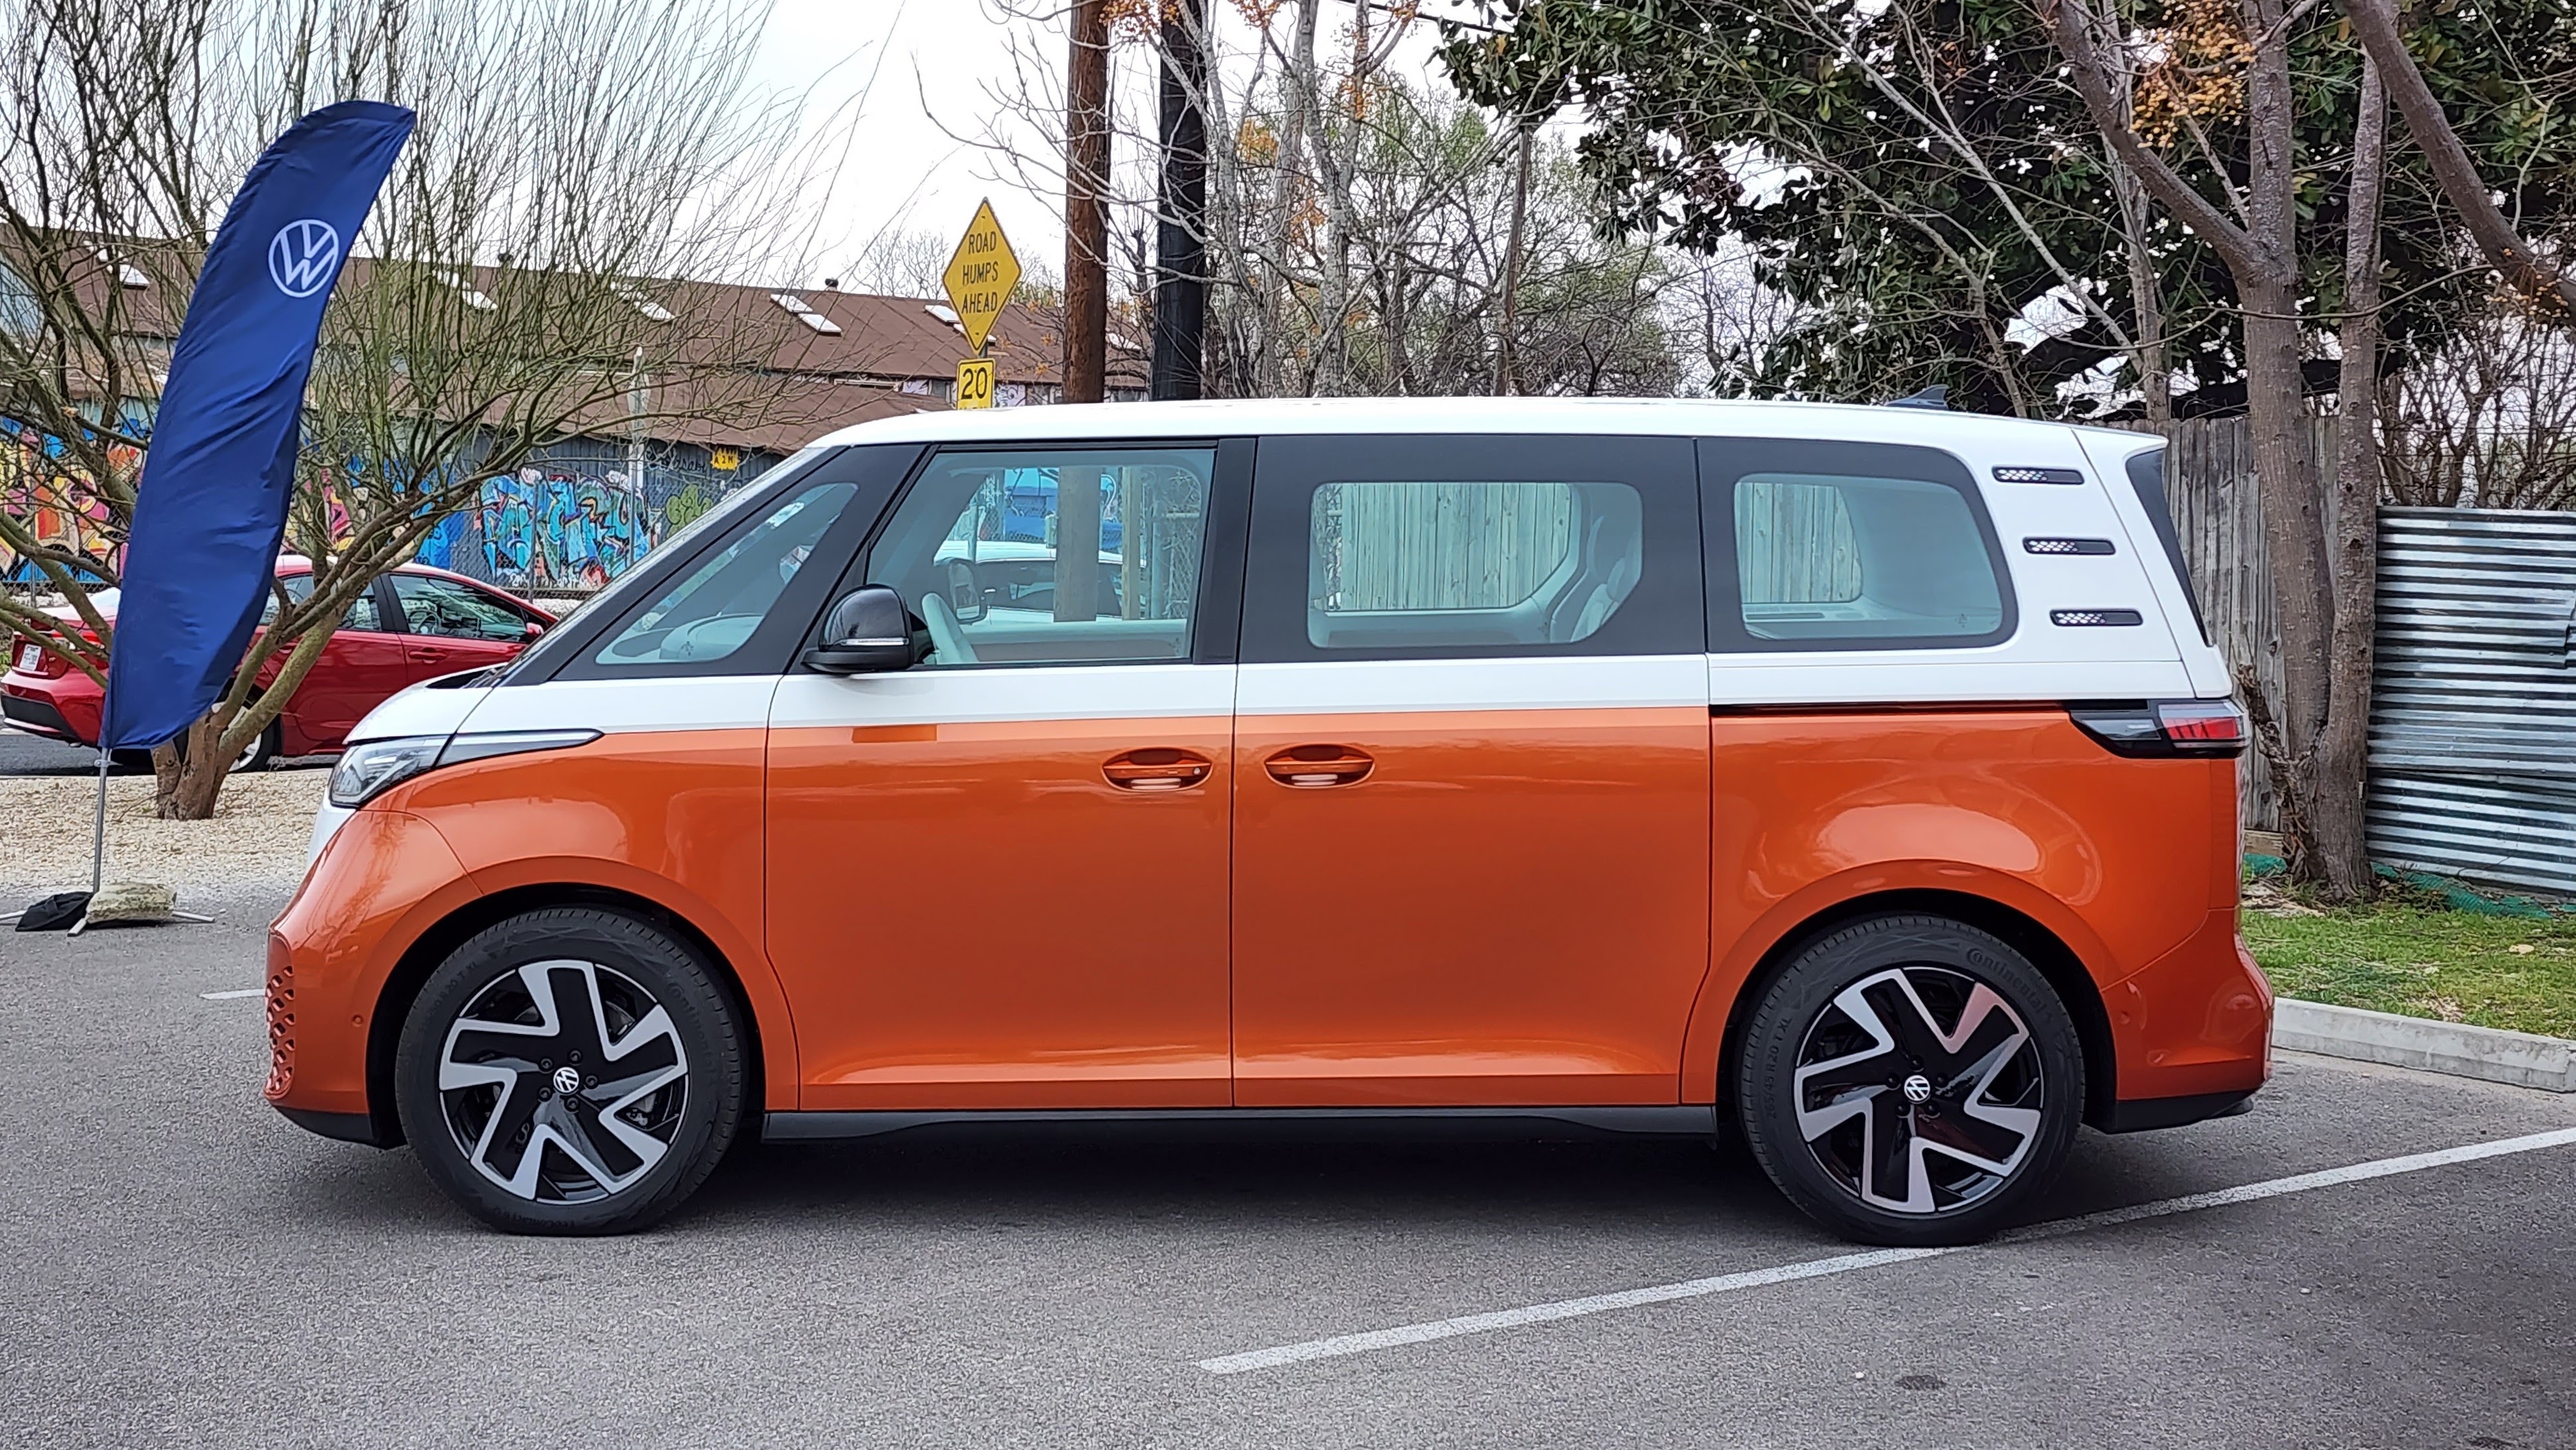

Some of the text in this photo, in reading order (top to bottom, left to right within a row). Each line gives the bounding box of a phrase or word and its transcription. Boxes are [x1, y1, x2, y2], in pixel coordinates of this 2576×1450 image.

[968, 231, 997, 255] ROAD
[962, 261, 998, 285] HUMPS
[961, 291, 998, 314] AHEAD
[961, 367, 988, 399] 20
[1966, 948, 2048, 1014] Continental
[1777, 1017, 1793, 1033] XL
